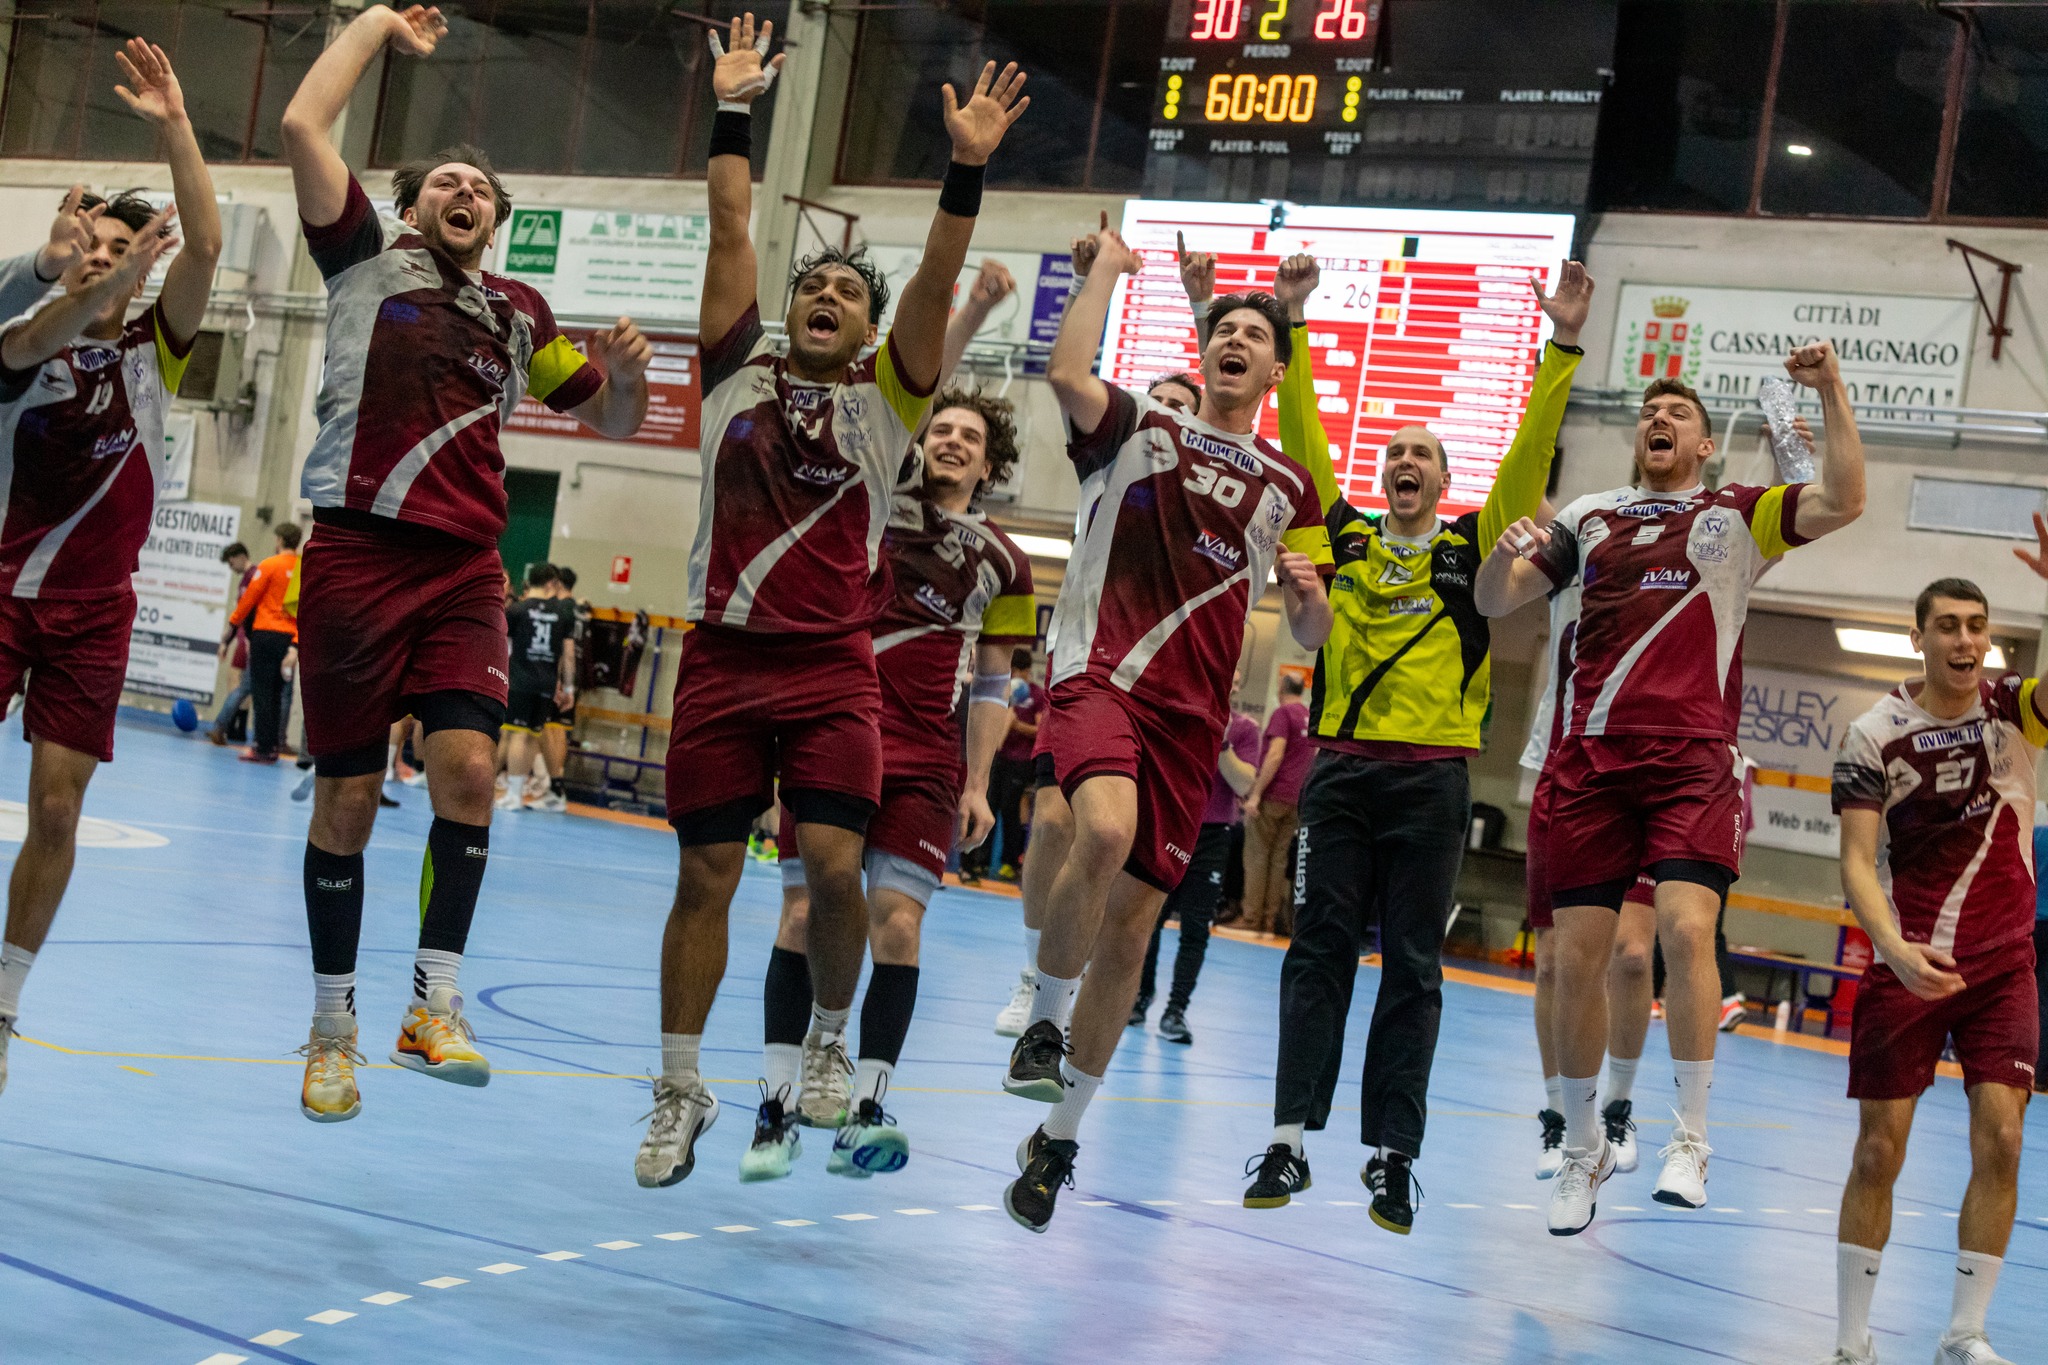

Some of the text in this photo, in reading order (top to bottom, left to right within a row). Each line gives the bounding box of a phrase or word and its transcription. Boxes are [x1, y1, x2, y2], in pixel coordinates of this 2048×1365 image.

[1191, 0, 1366, 40] 30 2 26
[1243, 44, 1291, 58] PERIOD
[1205, 74, 1318, 122] 60:00
[1154, 140, 1176, 151] SET
[1330, 143, 1353, 154] SET
[508, 252, 555, 268] agenzia
[1343, 283, 1371, 309] 26
[1793, 302, 1881, 326] CITTÀ DI
[1833, 337, 1959, 368] MAGNAGO
[1183, 463, 1247, 509] 30
[155, 507, 234, 537] GESTIONALE
[165, 536, 193, 556] CENTRI
[1631, 525, 1666, 546] 5
[1738, 709, 1833, 751] ESIGN
[1935, 757, 1976, 793] 27
[1768, 809, 1800, 828] Web
[1294, 826, 1310, 905] Kempa
[316, 877, 353, 888] SELECT
